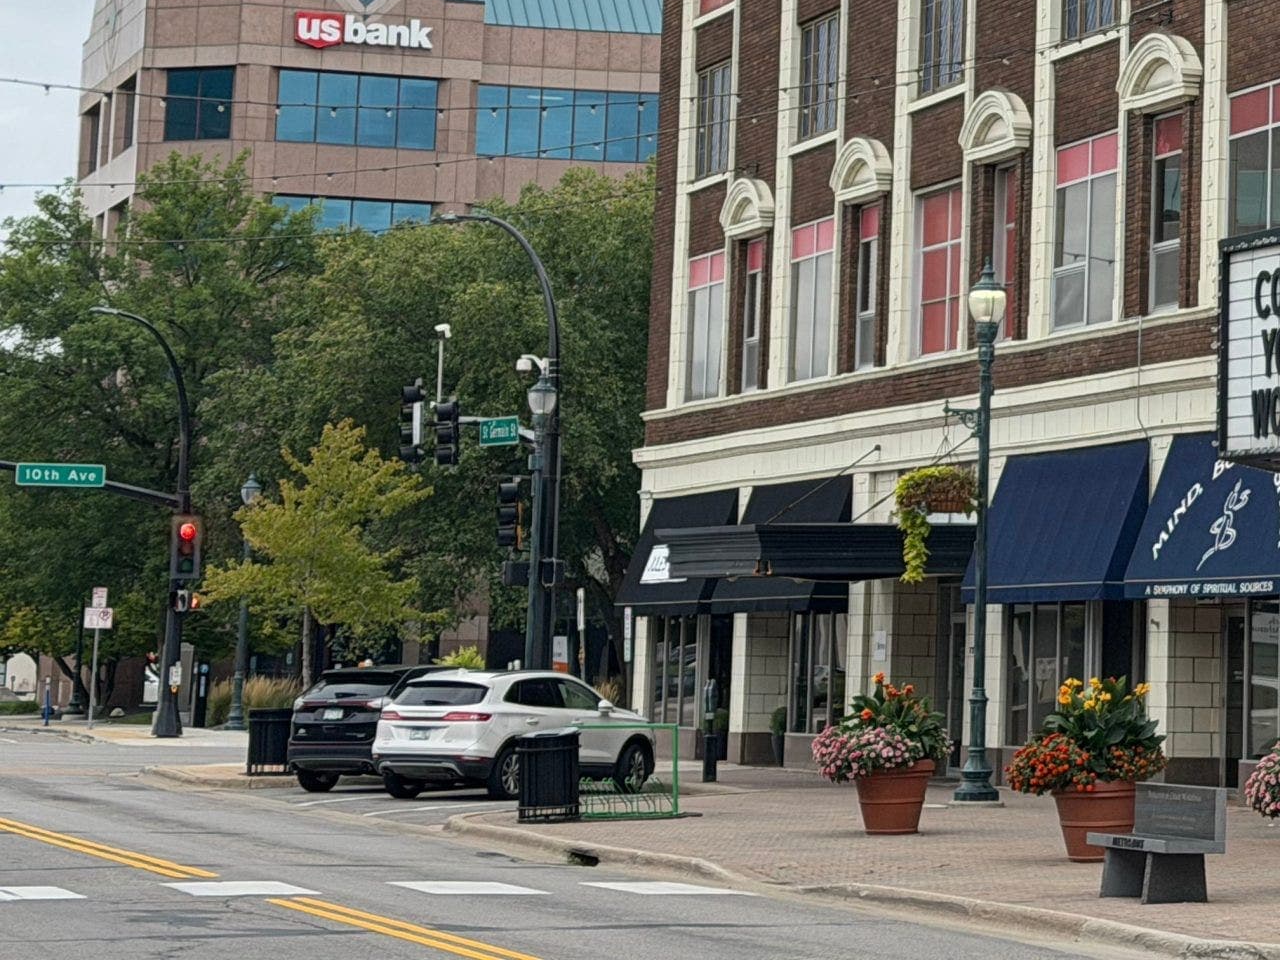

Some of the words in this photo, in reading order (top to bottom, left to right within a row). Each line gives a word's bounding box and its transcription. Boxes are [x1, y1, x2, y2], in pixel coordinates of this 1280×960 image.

[297, 17, 341, 41] us
[344, 14, 433, 49] bank
[25, 468, 60, 481] 10th
[67, 469, 97, 482] Ave
[1144, 585, 1152, 595] A
[1190, 583, 1201, 594] OF
[1202, 582, 1237, 594] SPIRITUAL
[1239, 580, 1274, 593] SOURCES
